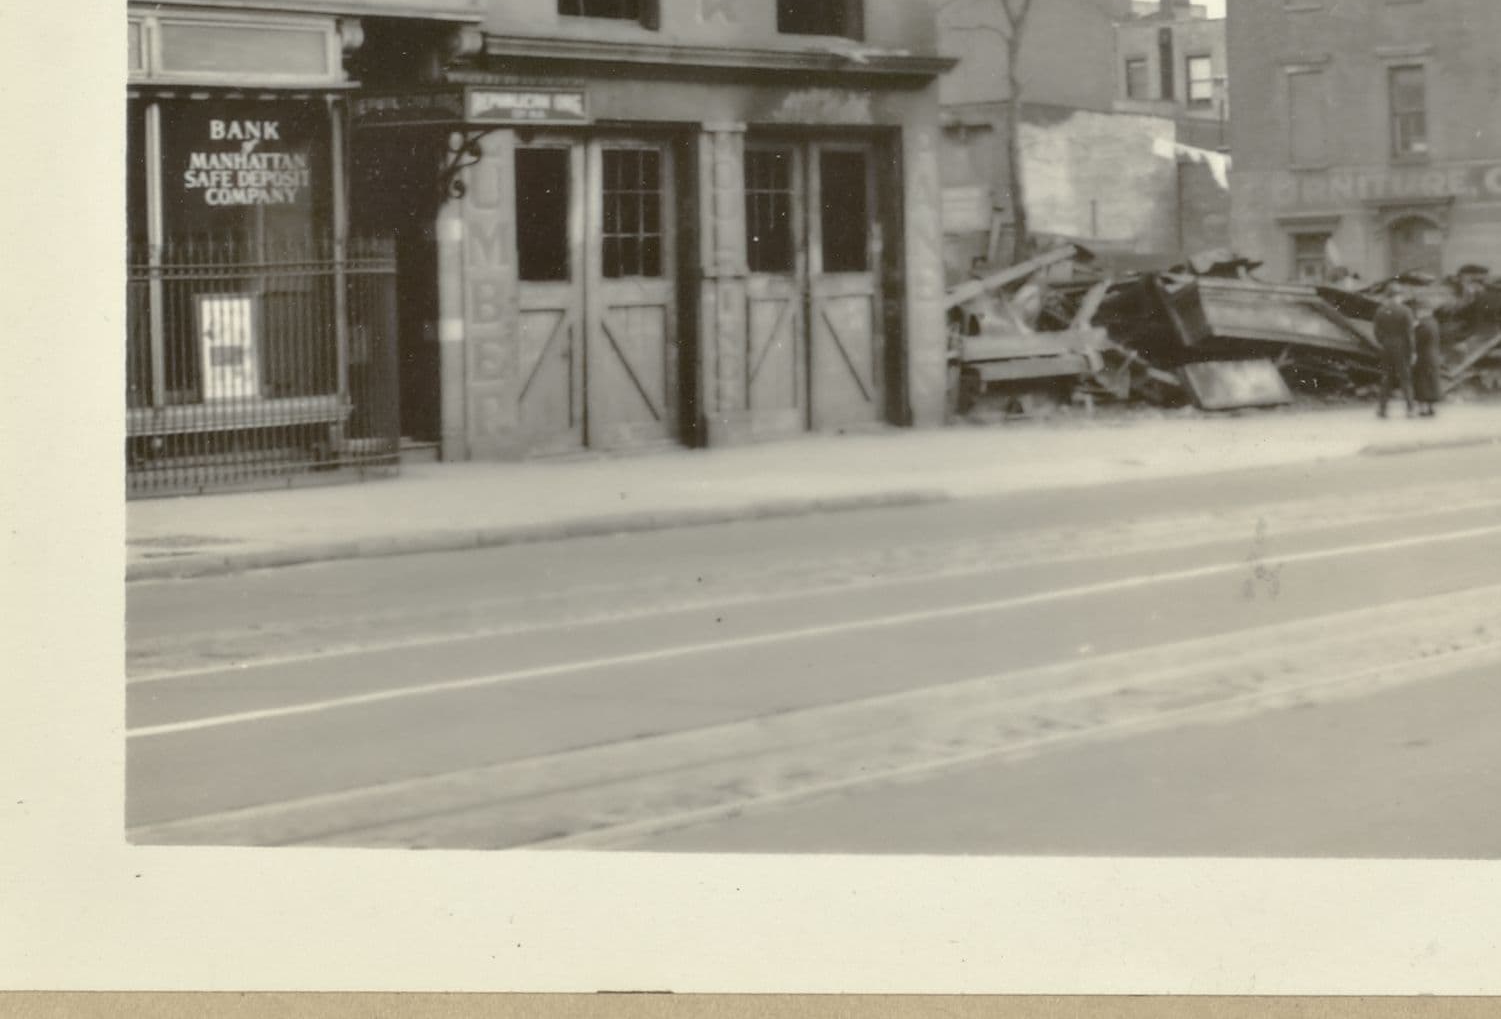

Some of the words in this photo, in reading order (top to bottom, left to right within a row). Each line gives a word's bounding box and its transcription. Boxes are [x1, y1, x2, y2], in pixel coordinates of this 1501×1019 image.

[209, 119, 280, 141] BANK
[189, 152, 307, 170] MANHATTAN
[183, 170, 234, 189] SAFE
[237, 170, 309, 188] DEPOSIT
[204, 187, 297, 206] COMPANY
